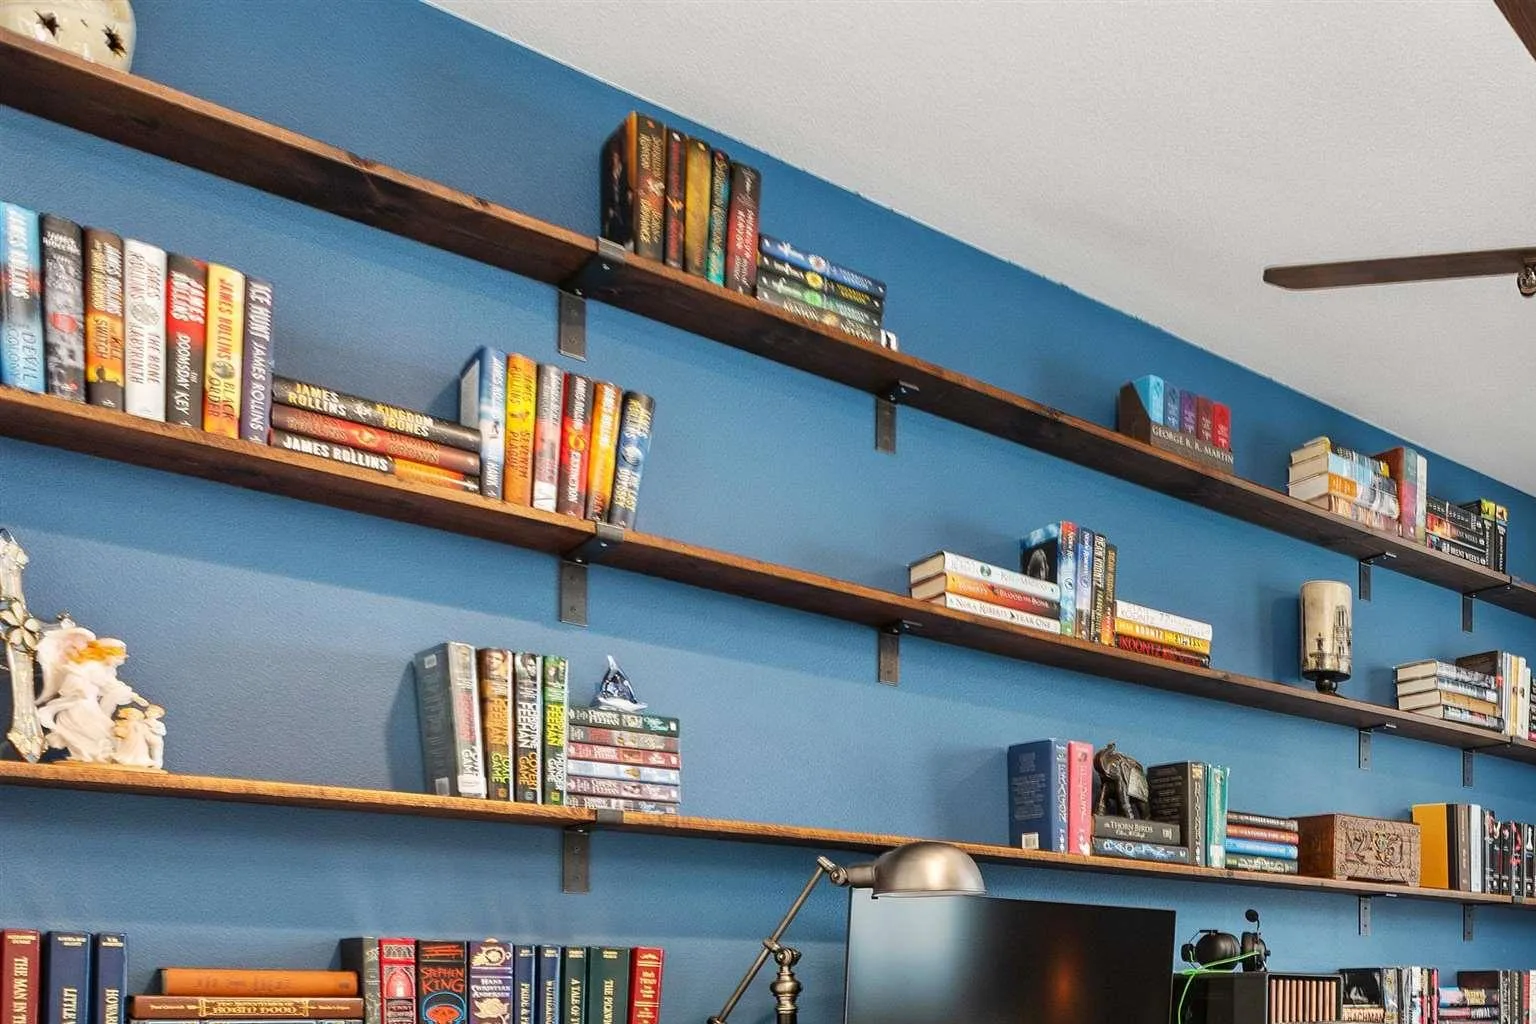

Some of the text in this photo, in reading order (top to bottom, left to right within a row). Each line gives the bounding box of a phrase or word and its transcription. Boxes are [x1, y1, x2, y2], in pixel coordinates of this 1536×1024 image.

[217, 278, 234, 360] JAMES ROLLINS
[95, 318, 108, 360] SWITCH
[129, 324, 143, 384] LABYRINTH
[249, 281, 271, 431] ICE HUNT JAMES ROLLINS
[174, 331, 191, 416] DOOMSDAY KEY
[288, 391, 347, 416] ROLLINS
[295, 383, 339, 403] JAMES
[283, 436, 388, 471] JAMES ROLLINS
[1152, 425, 1185, 445] GEORGE
[1204, 446, 1233, 464] MARTIN
[486, 462, 498, 488] HAWK
[1094, 535, 1104, 588] DEAN KOONTZ
[519, 702, 530, 748] FEEHAN
[548, 704, 558, 746] FEEHAN
[462, 749, 473, 776] GAM
[491, 751, 502, 784] GAME
[519, 756, 529, 786] GAME
[529, 751, 538, 790] COVERT
[547, 758, 556, 783] GAME
[555, 752, 565, 790] THUNDER
[14, 956, 28, 977] THE
[421, 967, 464, 978] STEPHEN
[13, 979, 28, 1000] MAN
[422, 978, 465, 993] KING
[520, 983, 530, 1008] PRIDE
[570, 986, 580, 1004] TALE
[604, 980, 613, 996] THE
[13, 1002, 27, 1013] IN
[62, 988, 78, 1019] LITTLE
[521, 1008, 529, 1016] &
[545, 980, 554, 1024] WUTHERING
[570, 1006, 579, 1015] OF
